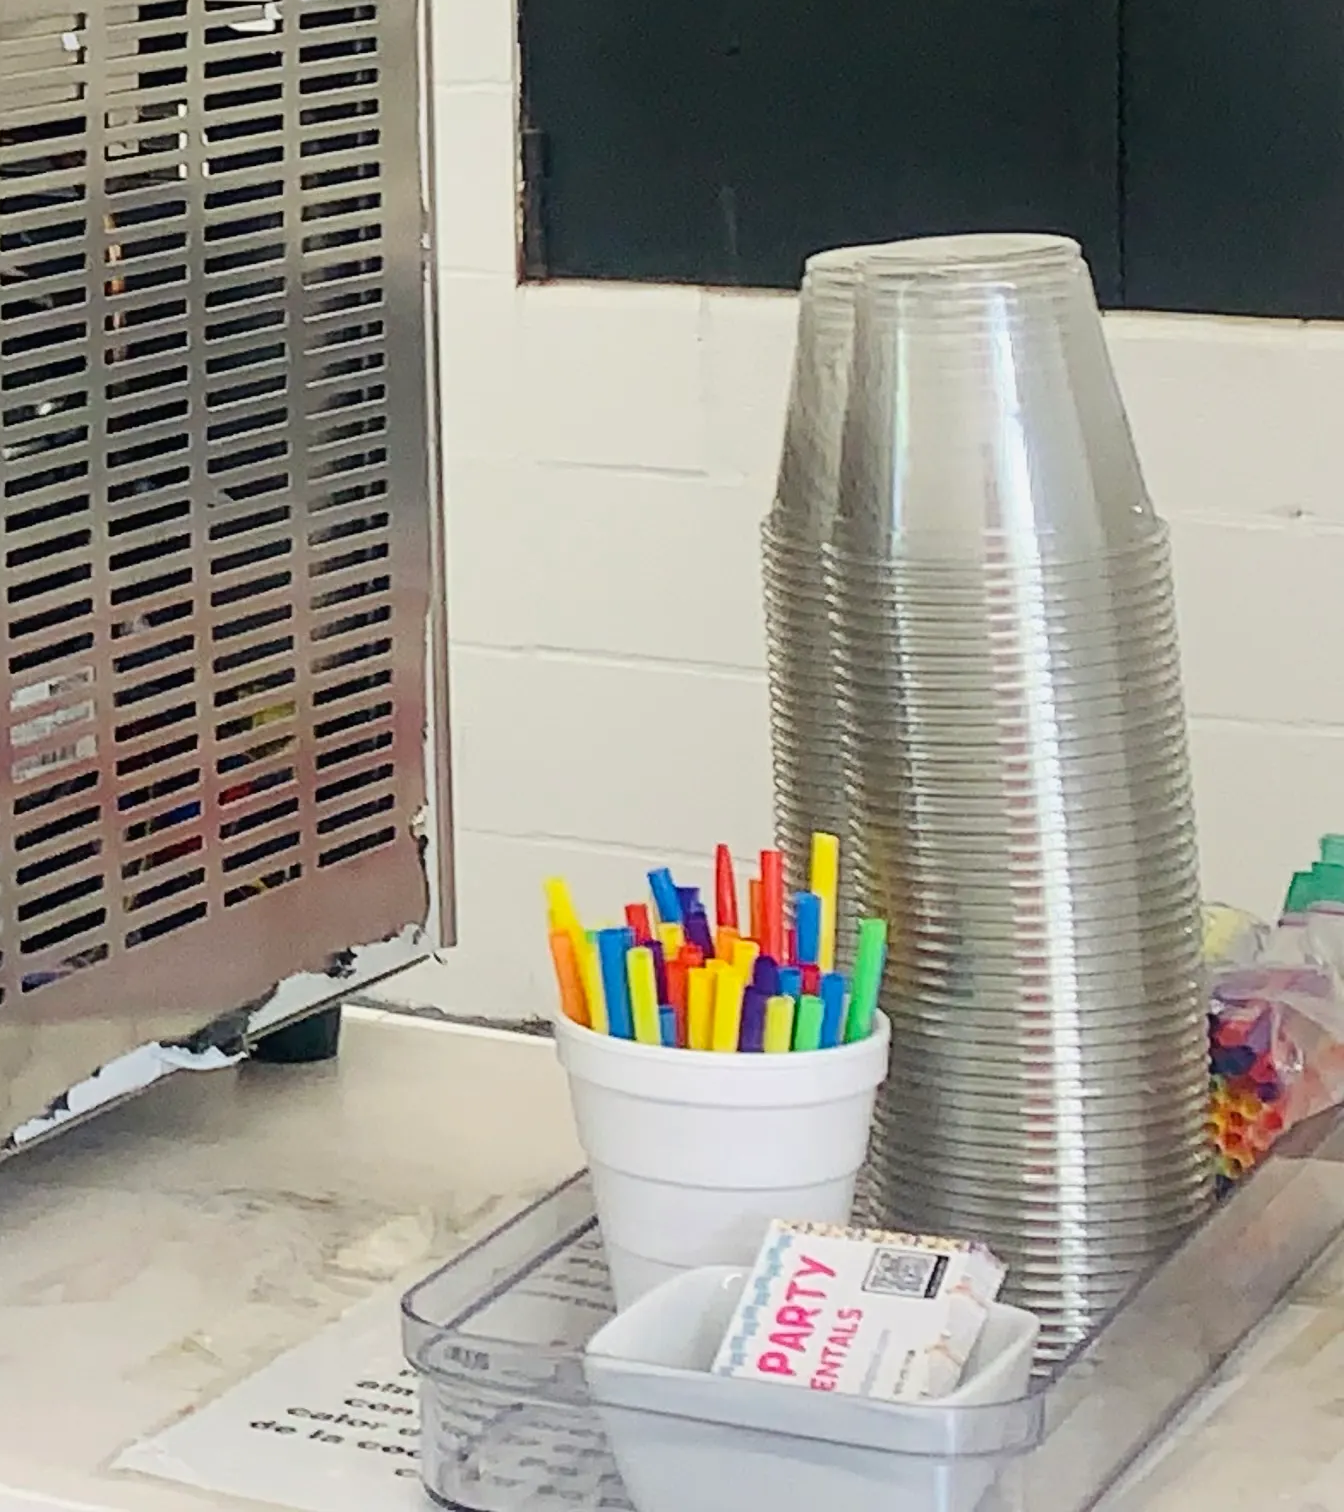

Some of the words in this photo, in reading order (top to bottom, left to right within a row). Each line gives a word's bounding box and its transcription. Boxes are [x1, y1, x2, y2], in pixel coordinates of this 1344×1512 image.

[756, 1254, 837, 1377] PARTY
[809, 1307, 864, 1392] ENTALS
[250, 1420, 297, 1435] de
[309, 1429, 345, 1444] la
[286, 1407, 388, 1430] calor
